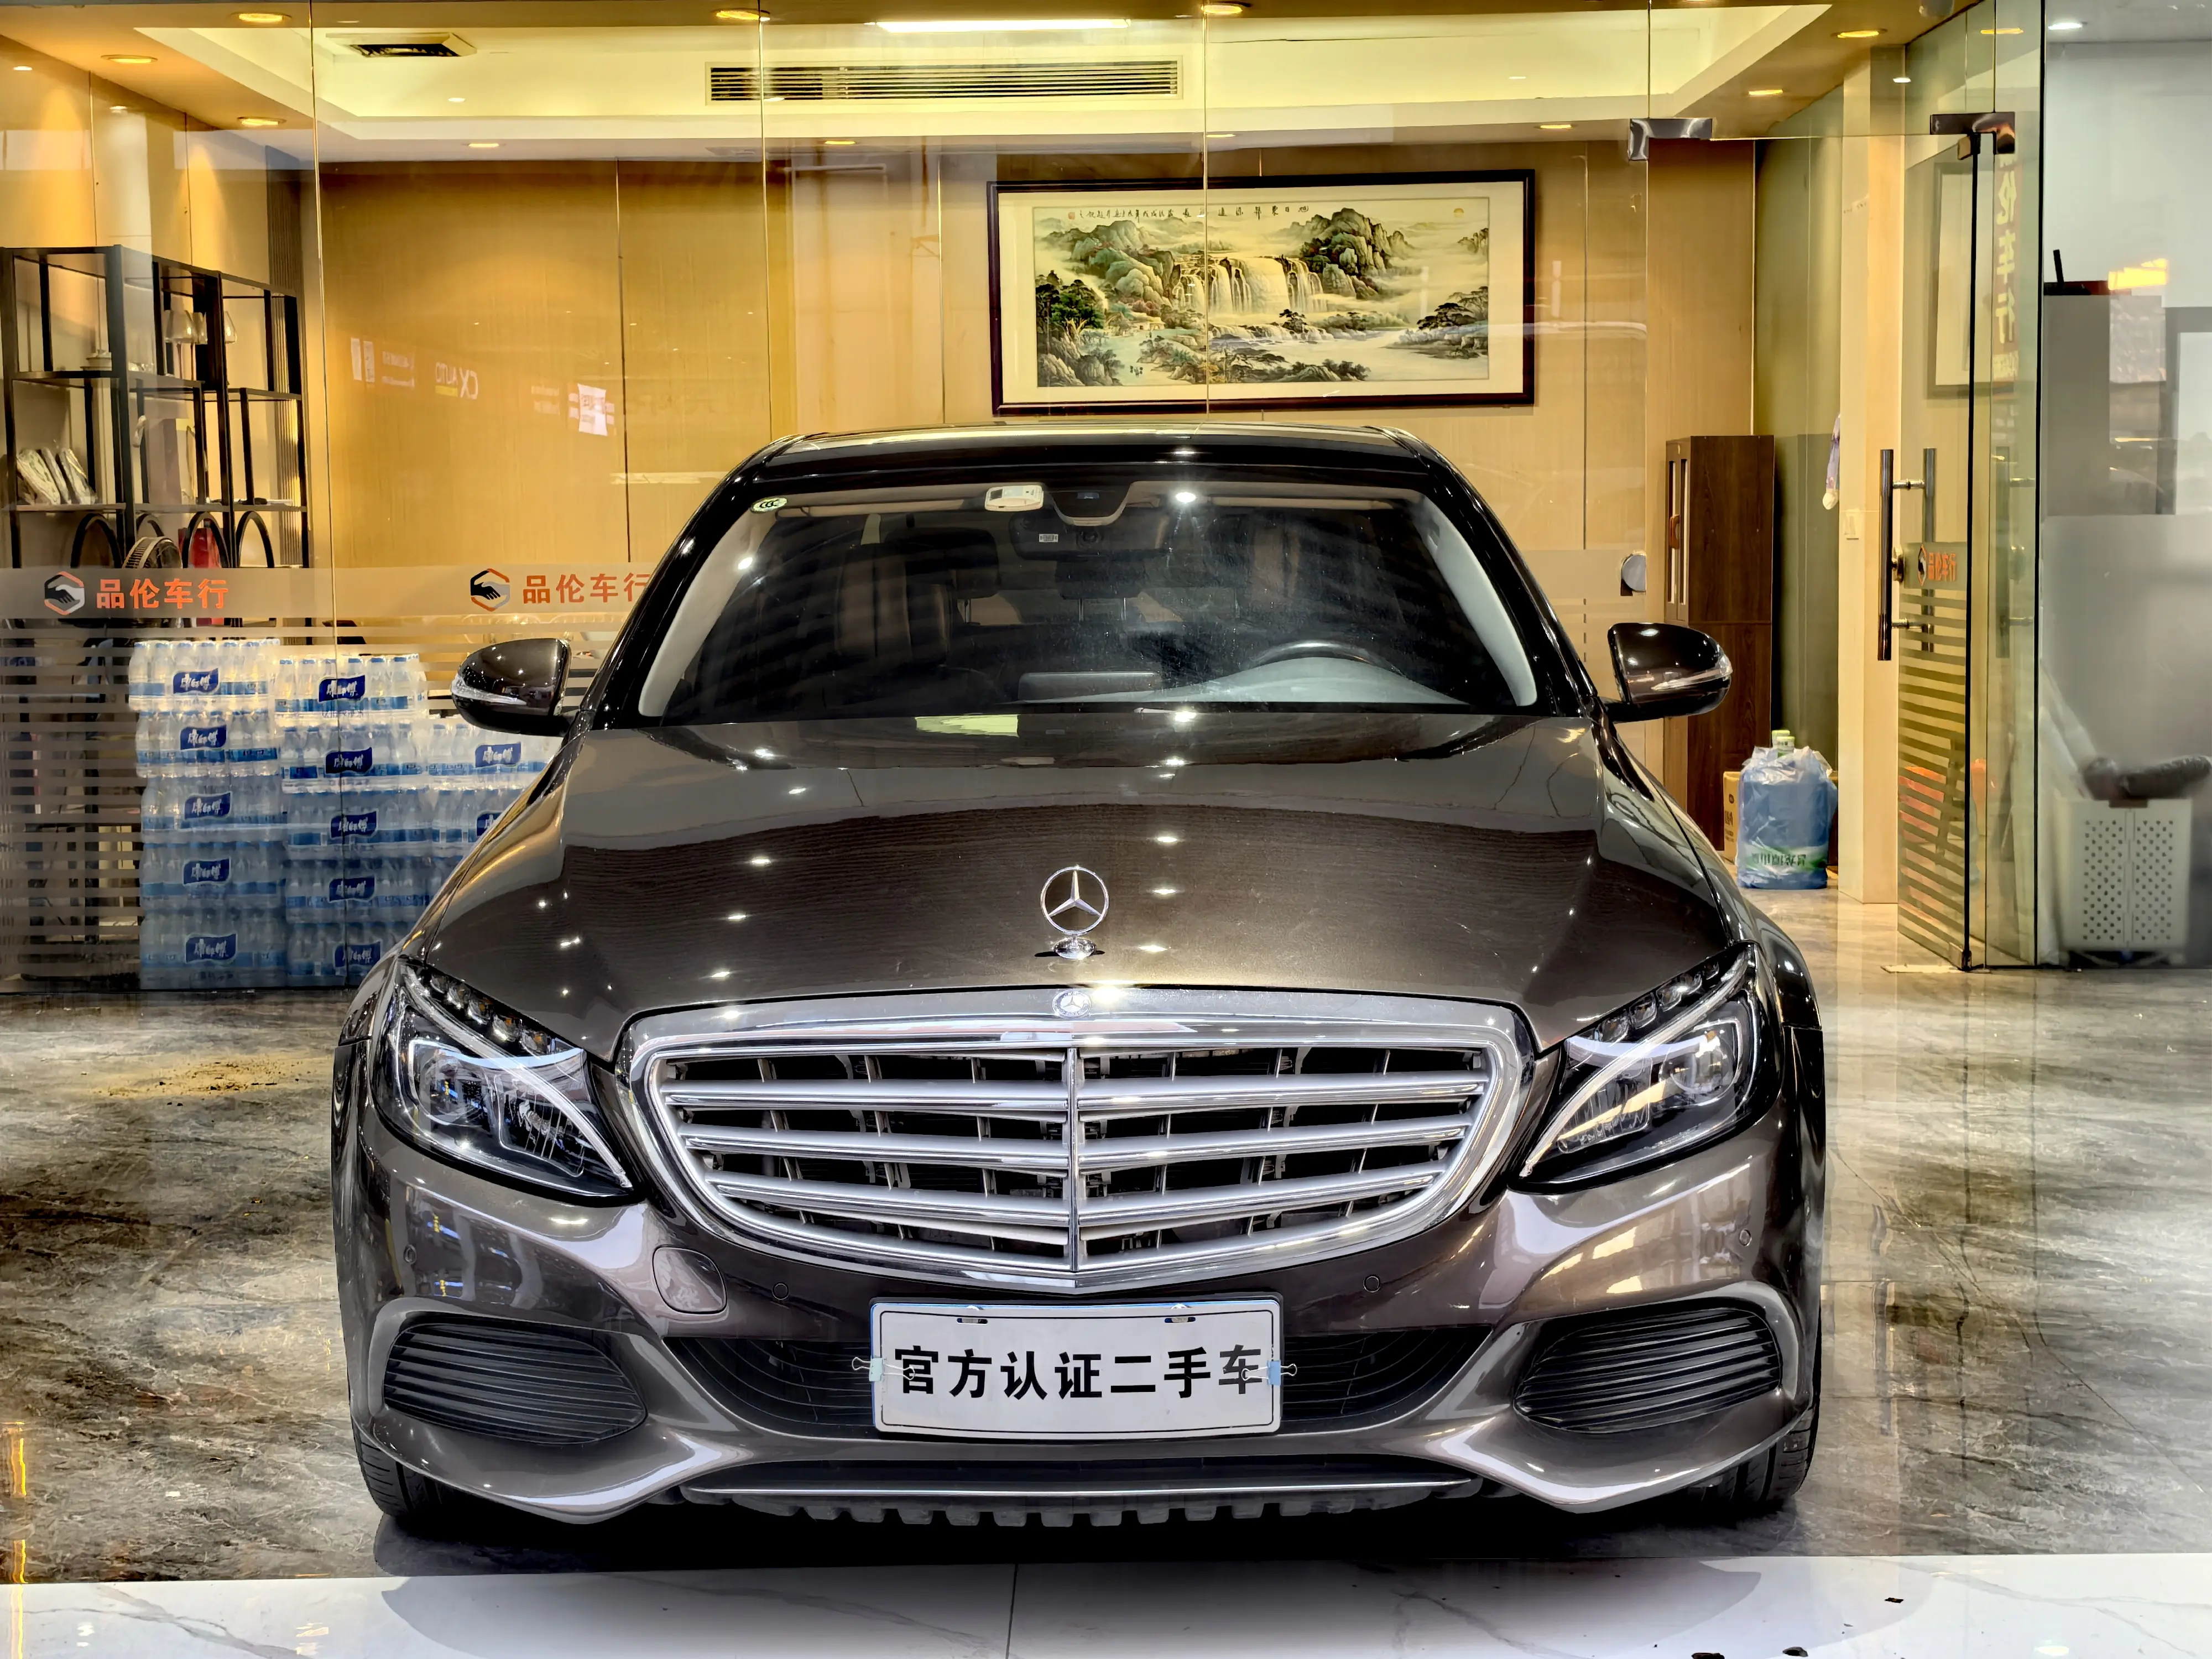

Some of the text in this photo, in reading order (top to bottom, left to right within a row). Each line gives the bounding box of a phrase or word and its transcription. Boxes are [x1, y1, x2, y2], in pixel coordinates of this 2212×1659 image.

[96, 578, 229, 609] 品伦车行
[523, 573, 651, 604] 品伦车行
[895, 1344, 1262, 1400] 官方认证二手车
